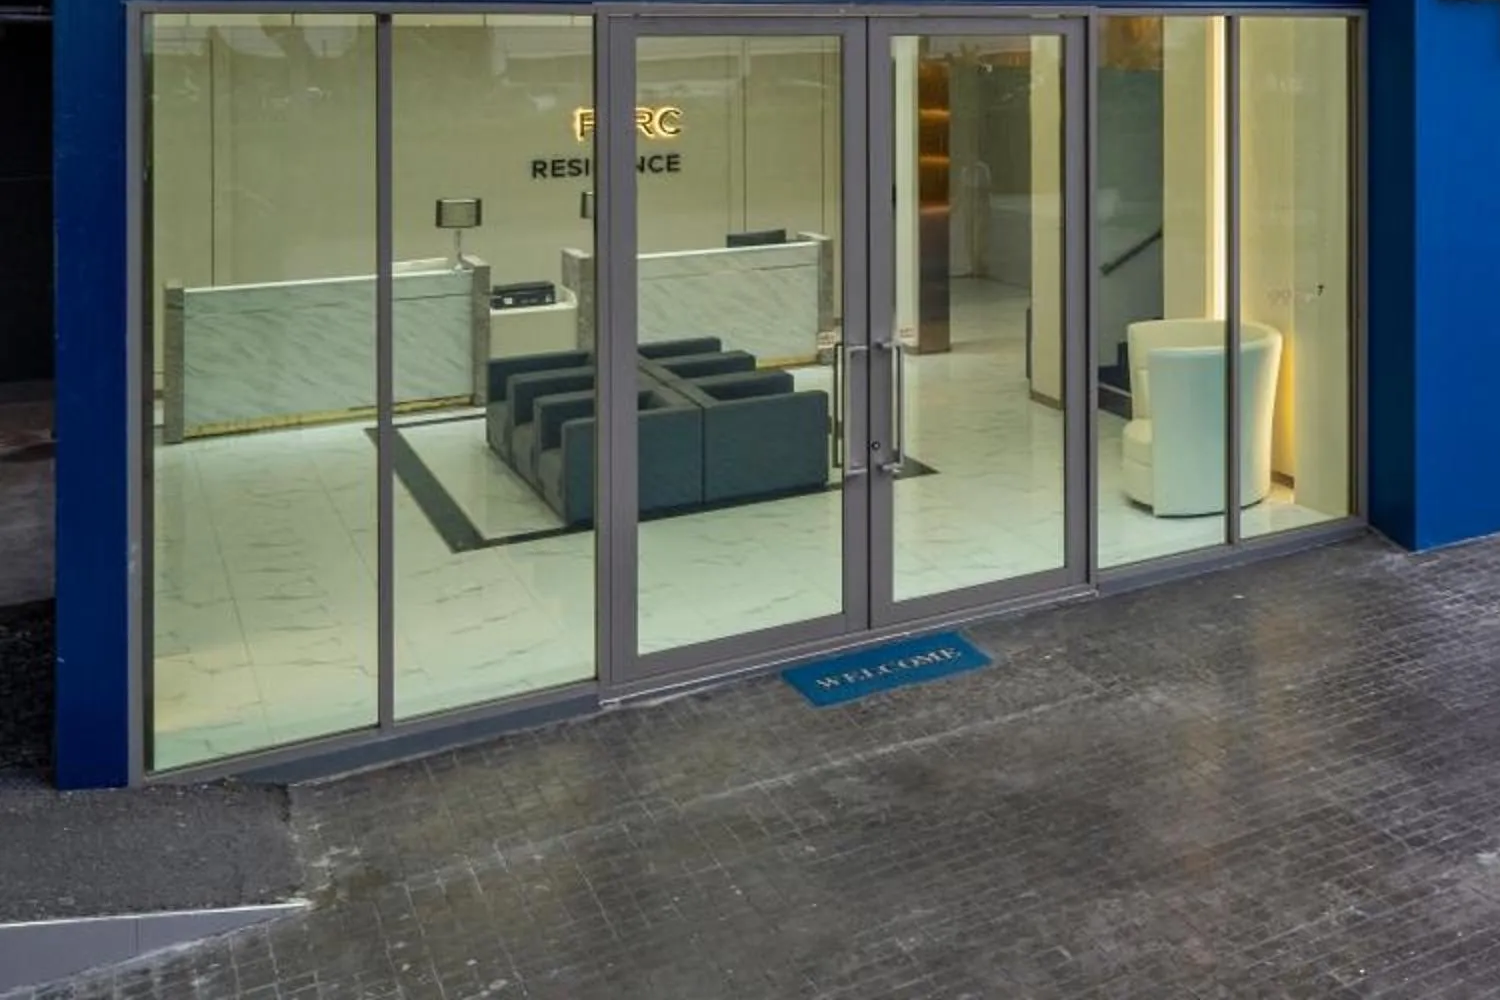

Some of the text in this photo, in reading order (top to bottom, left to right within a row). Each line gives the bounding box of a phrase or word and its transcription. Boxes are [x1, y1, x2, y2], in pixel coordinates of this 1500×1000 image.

[575, 107, 682, 140] PRC
[531, 153, 681, 179] RESINCE
[815, 646, 963, 690] WELCOME
